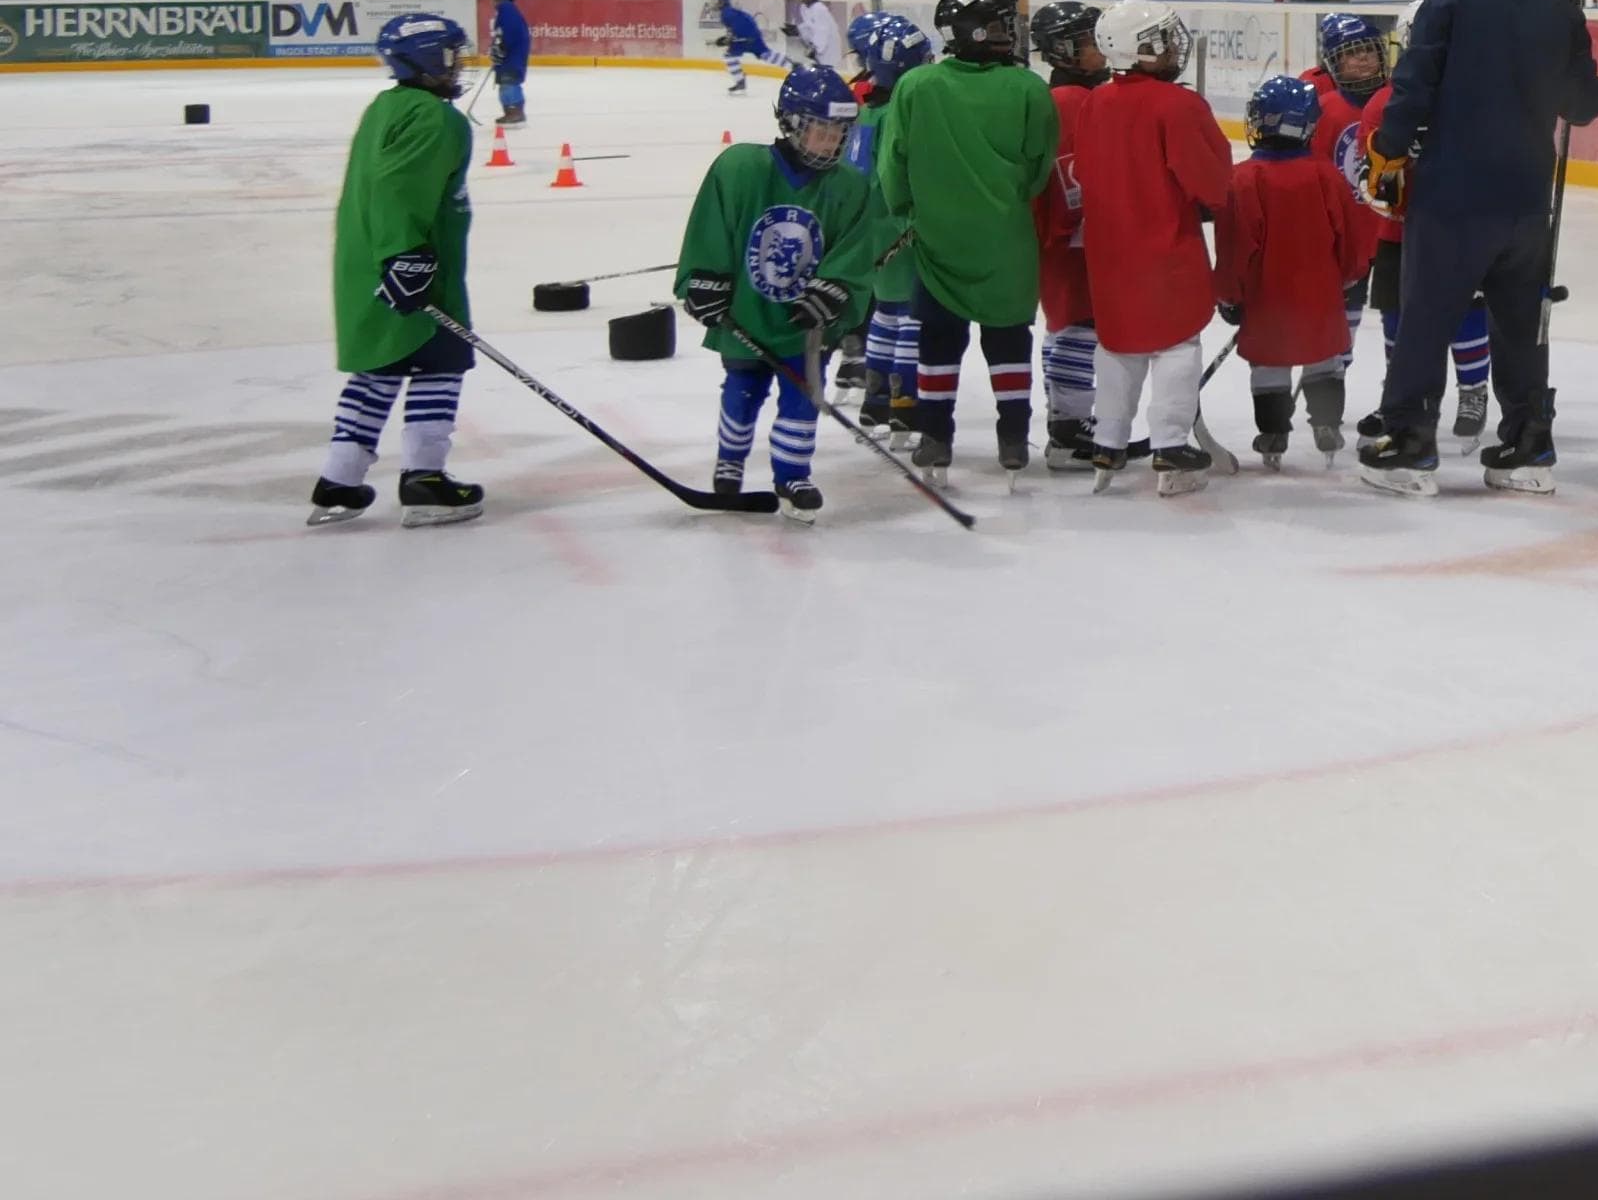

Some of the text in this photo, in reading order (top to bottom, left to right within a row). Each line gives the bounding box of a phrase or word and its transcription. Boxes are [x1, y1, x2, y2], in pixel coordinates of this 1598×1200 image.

[25, 4, 265, 38] HERRNBRÄU
[271, 1, 359, 37] DVM
[529, 23, 678, 42] arkasse Ingolstadt Eichstätt
